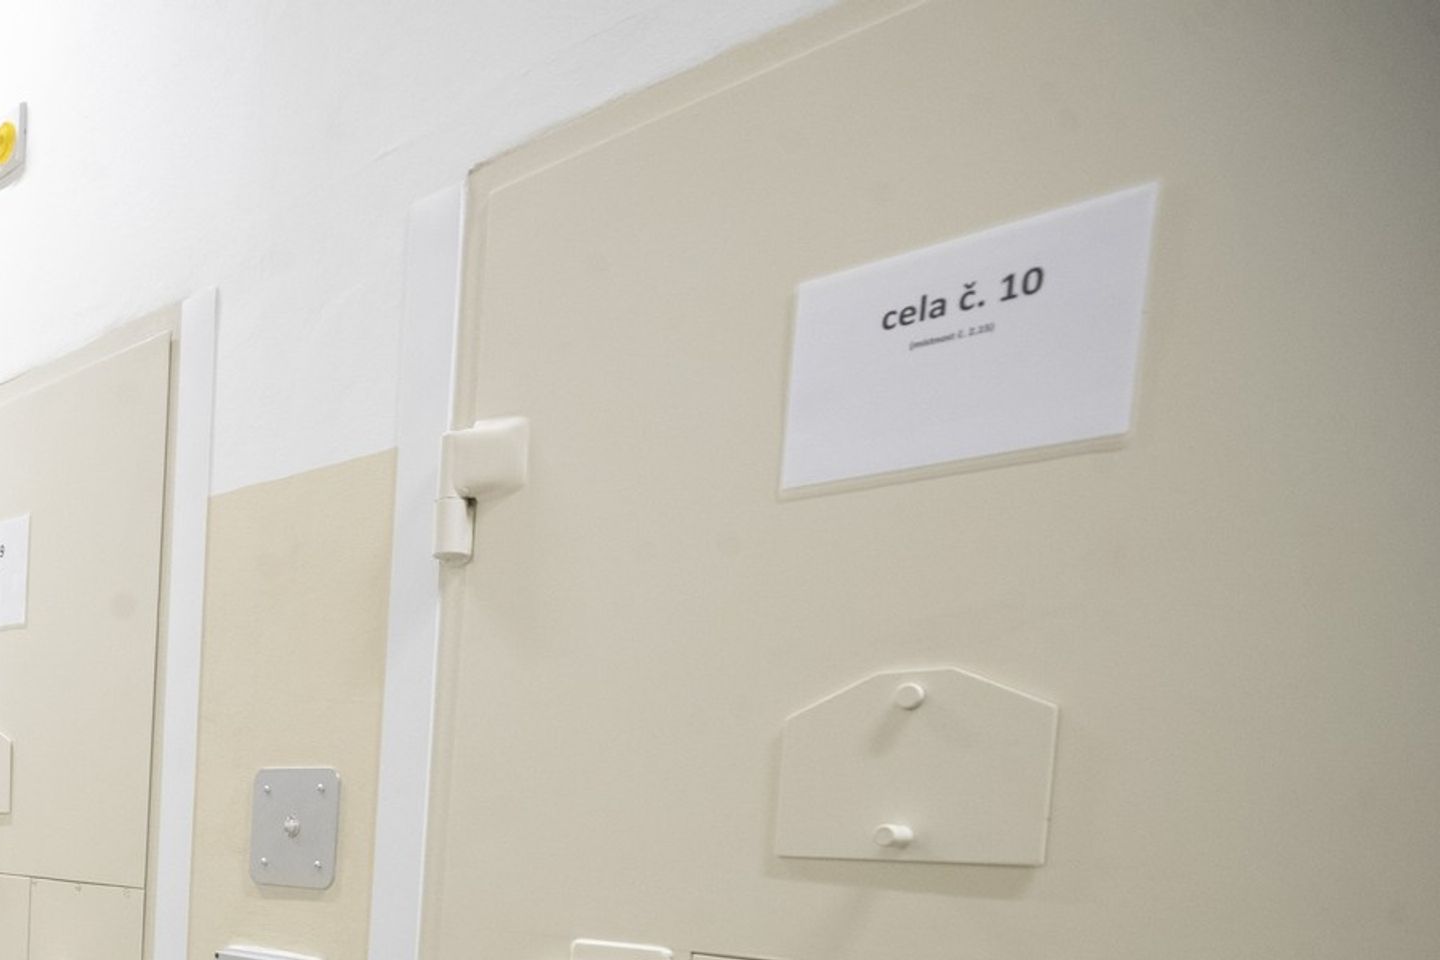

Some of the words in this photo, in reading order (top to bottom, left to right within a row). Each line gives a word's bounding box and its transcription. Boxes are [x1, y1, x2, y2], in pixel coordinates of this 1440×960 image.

[882, 294, 947, 331] cela
[959, 281, 985, 312] č.
[1000, 266, 1045, 302] 10
[0, 544, 5, 559] 9
